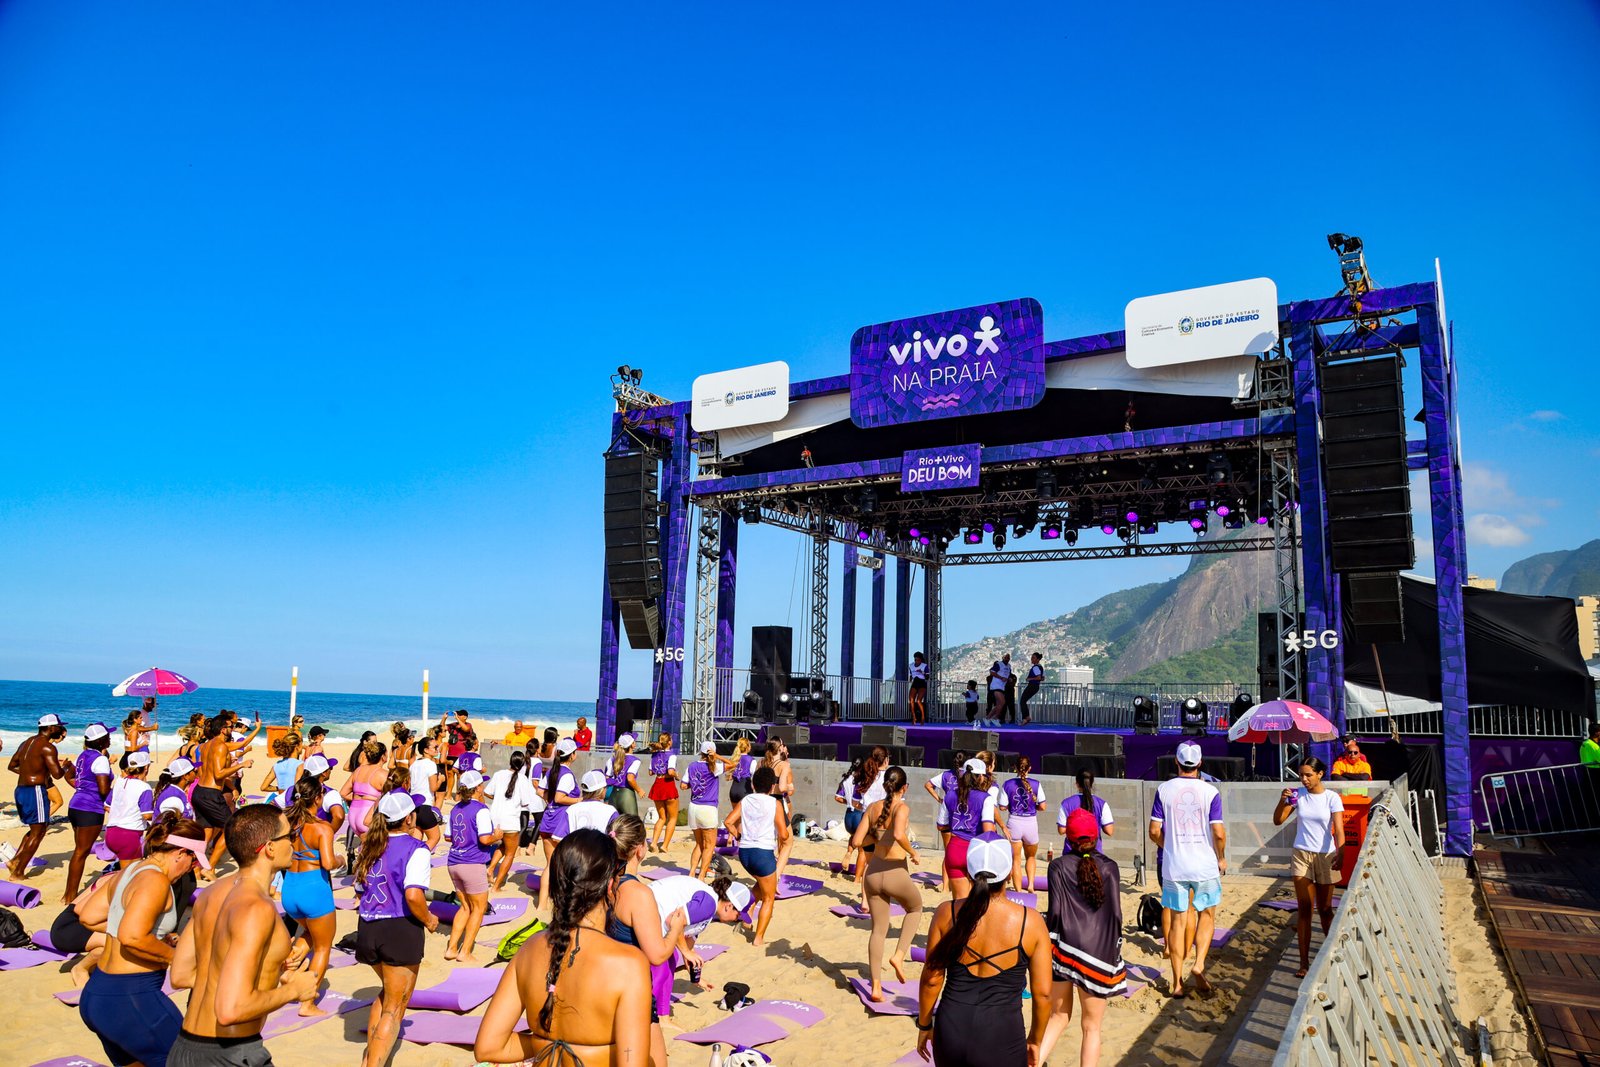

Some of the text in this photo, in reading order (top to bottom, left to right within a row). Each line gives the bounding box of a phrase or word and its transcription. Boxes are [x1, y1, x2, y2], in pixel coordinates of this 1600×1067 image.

[1196, 320, 1211, 328] RIO
[1224, 313, 1260, 324] JANEIRO
[889, 330, 968, 365] vivo
[893, 360, 997, 393] NA PRAIA
[754, 390, 776, 398] JANEIRO
[908, 464, 972, 483] DEU BOM
[1303, 630, 1339, 649] 5G
[665, 647, 685, 662] 5G
